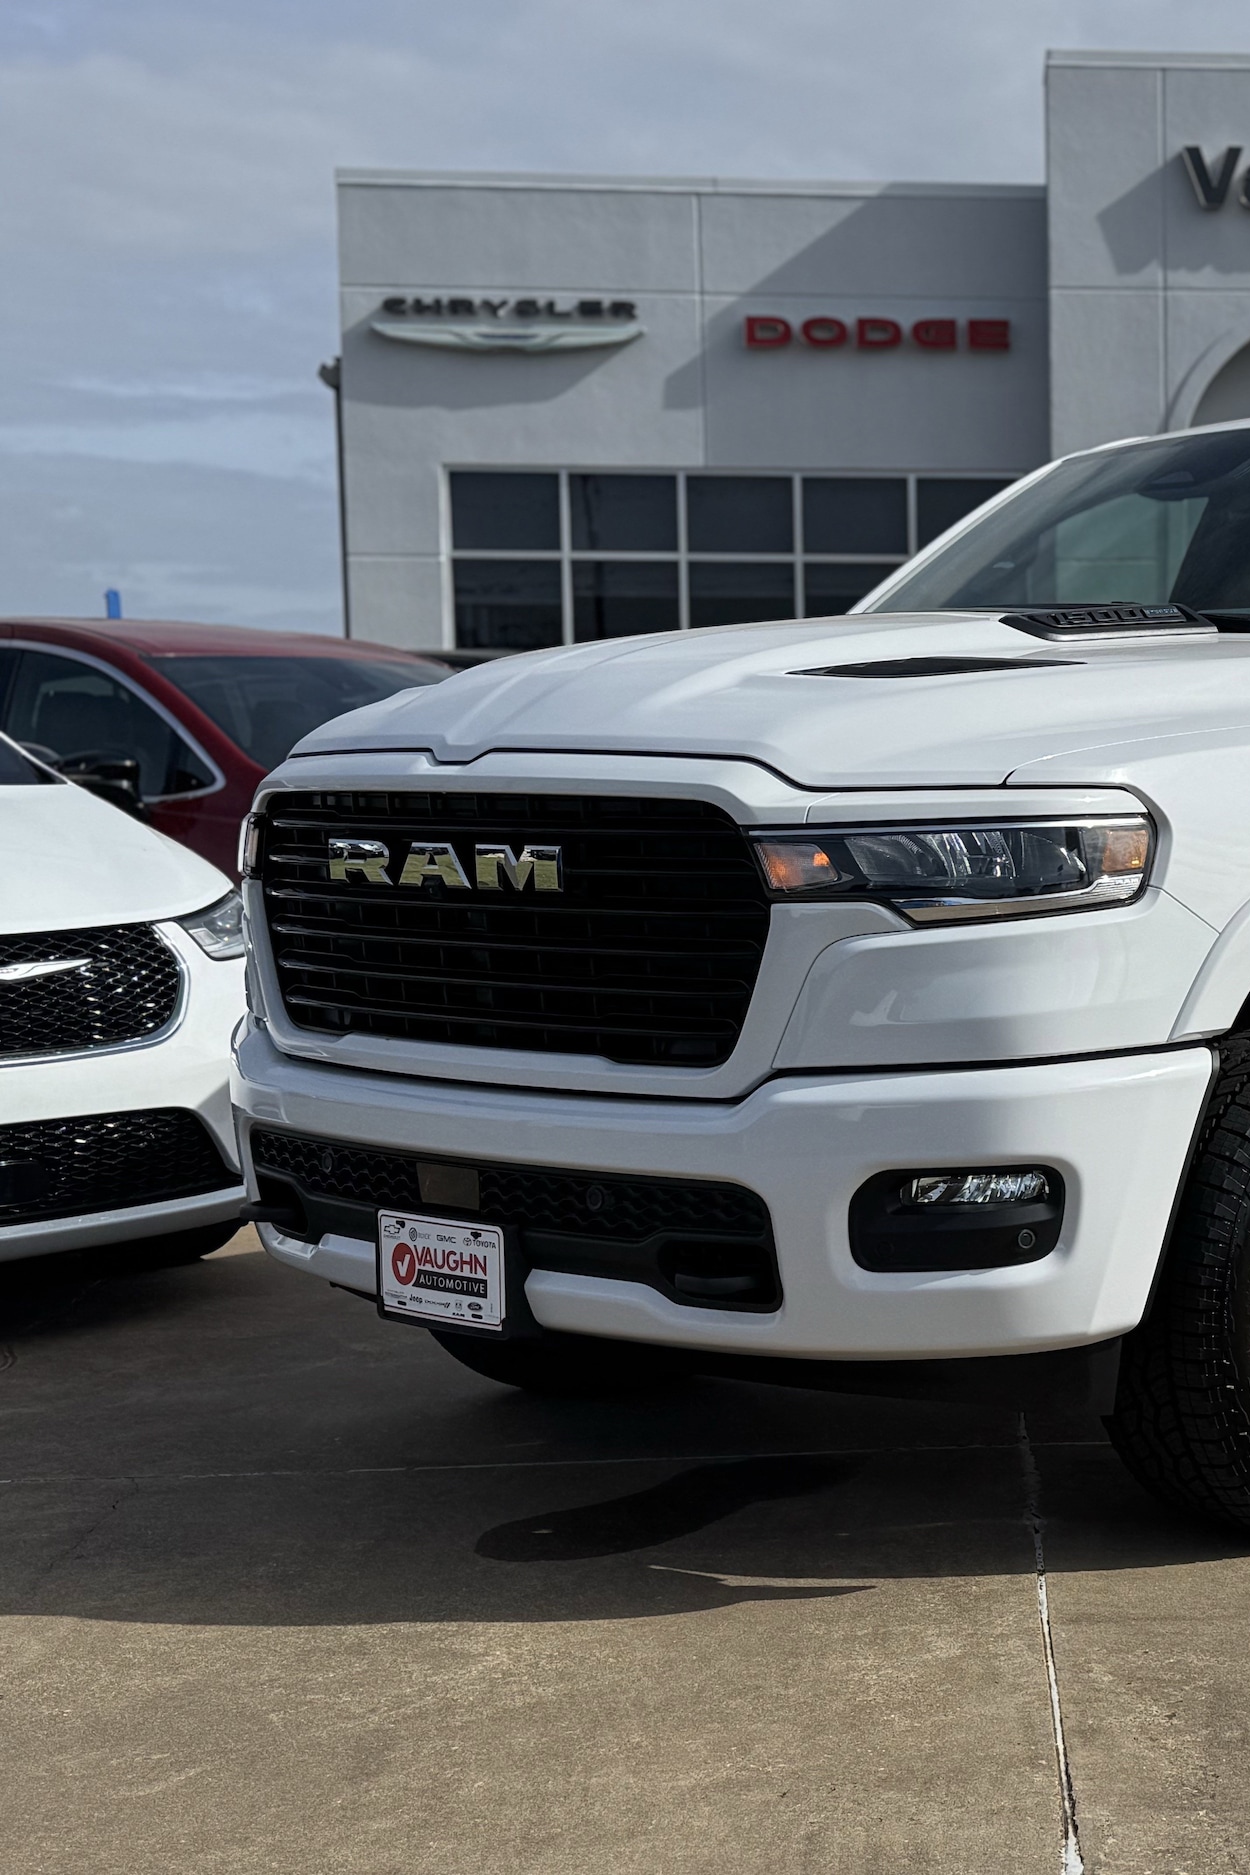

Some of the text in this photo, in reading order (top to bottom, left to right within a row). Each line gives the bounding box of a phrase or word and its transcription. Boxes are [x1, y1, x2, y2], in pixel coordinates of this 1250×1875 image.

[381, 296, 638, 319] CHRYSLER
[745, 316, 1012, 351] DODGE
[1050, 608, 1138, 625] 1500
[329, 838, 564, 893] RAM
[436, 1234, 457, 1244] GMC
[473, 1238, 496, 1249] TOYOTA
[413, 1245, 488, 1276] VAUGHN
[419, 1274, 486, 1294] AUTOMOTIVE
[409, 1294, 423, 1304] Jeep
